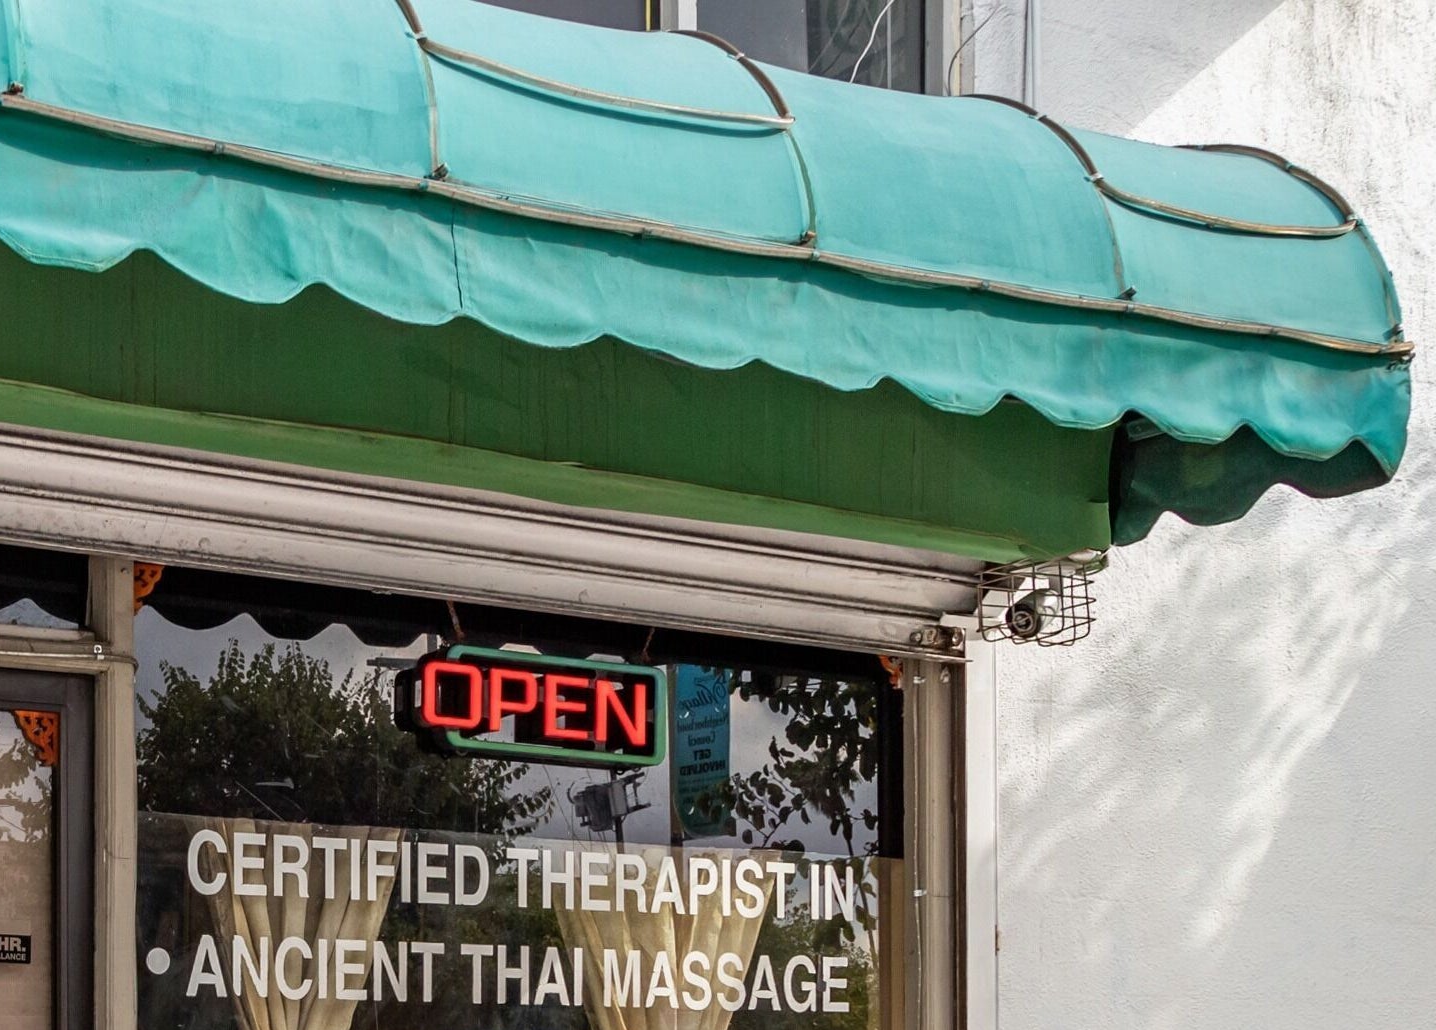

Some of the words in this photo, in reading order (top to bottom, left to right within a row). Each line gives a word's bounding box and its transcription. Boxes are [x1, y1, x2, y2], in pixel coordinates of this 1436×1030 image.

[421, 660, 648, 748] OPEN
[187, 829, 491, 906] CERTIFIED
[506, 847, 795, 919] THERAPIST
[809, 863, 855, 921] IN
[186, 934, 445, 1003] ANCIENT
[461, 943, 583, 1007] THAI
[603, 948, 850, 1013] MASSAGE
